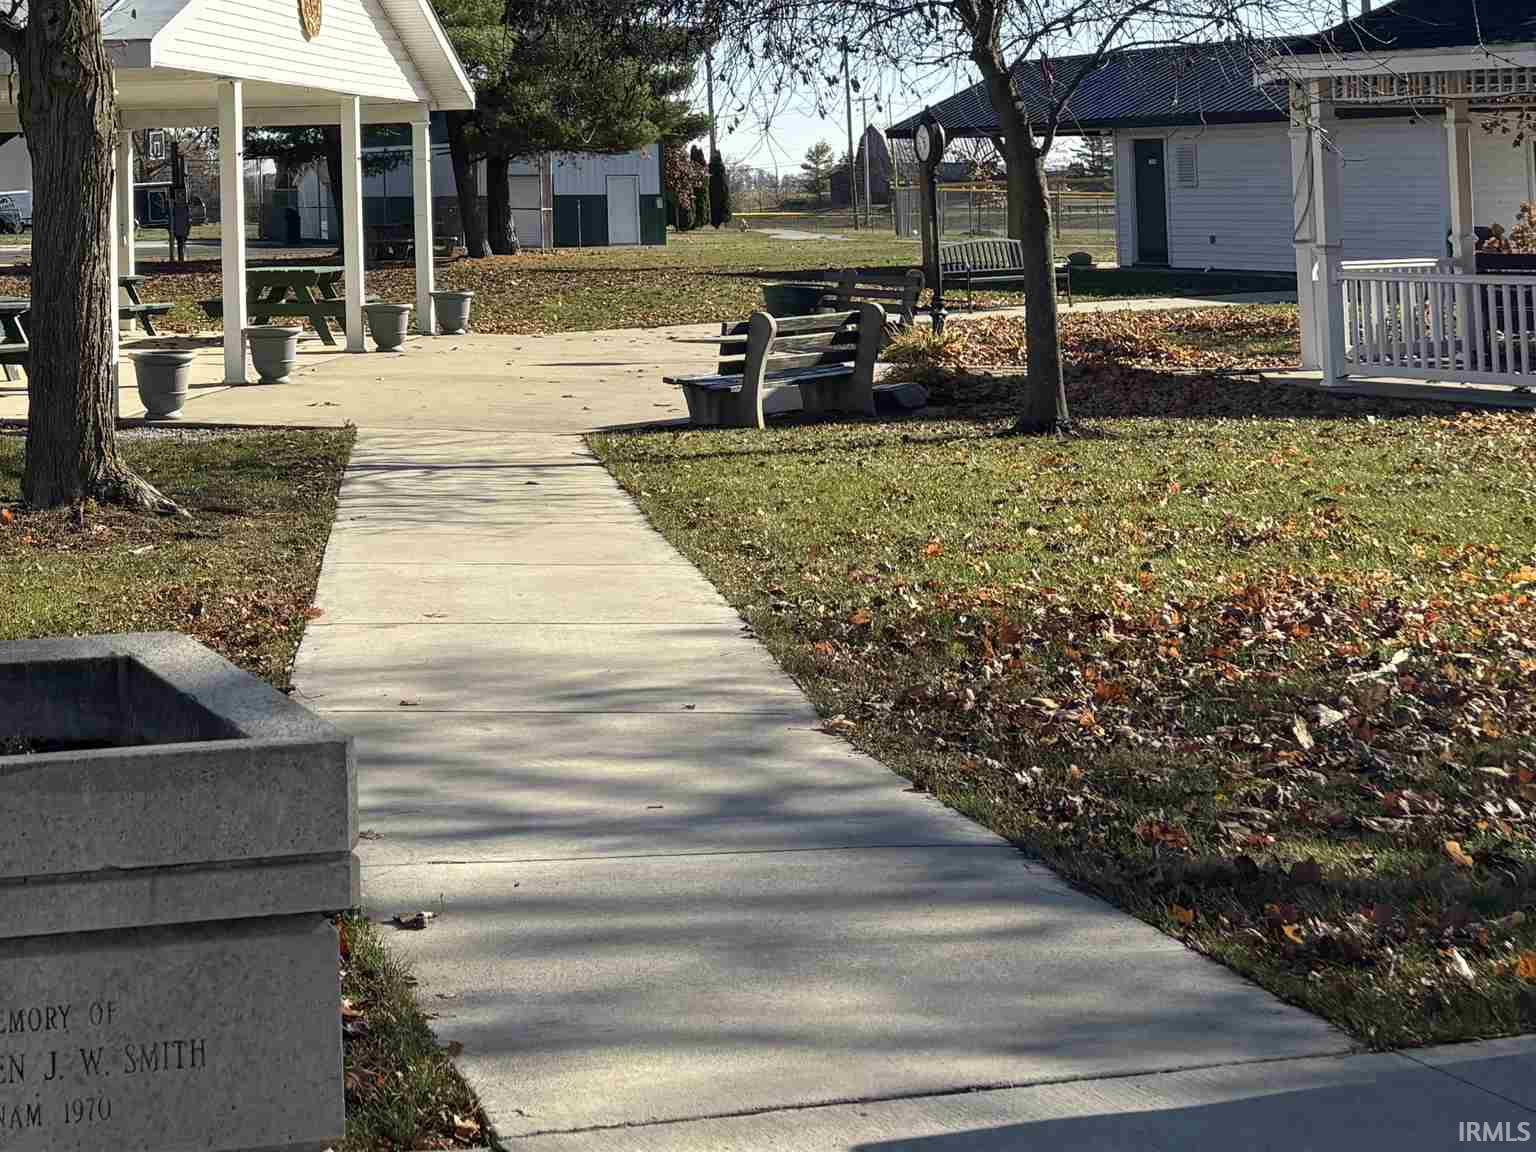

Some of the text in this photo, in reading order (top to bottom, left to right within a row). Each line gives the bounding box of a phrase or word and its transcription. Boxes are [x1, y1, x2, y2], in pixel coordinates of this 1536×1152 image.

[89, 1001, 118, 1026] OF
[43, 1051, 65, 1081] J.
[79, 1047, 110, 1077] W.
[123, 1038, 207, 1074] SMITH
[64, 1096, 112, 1124] 1970
